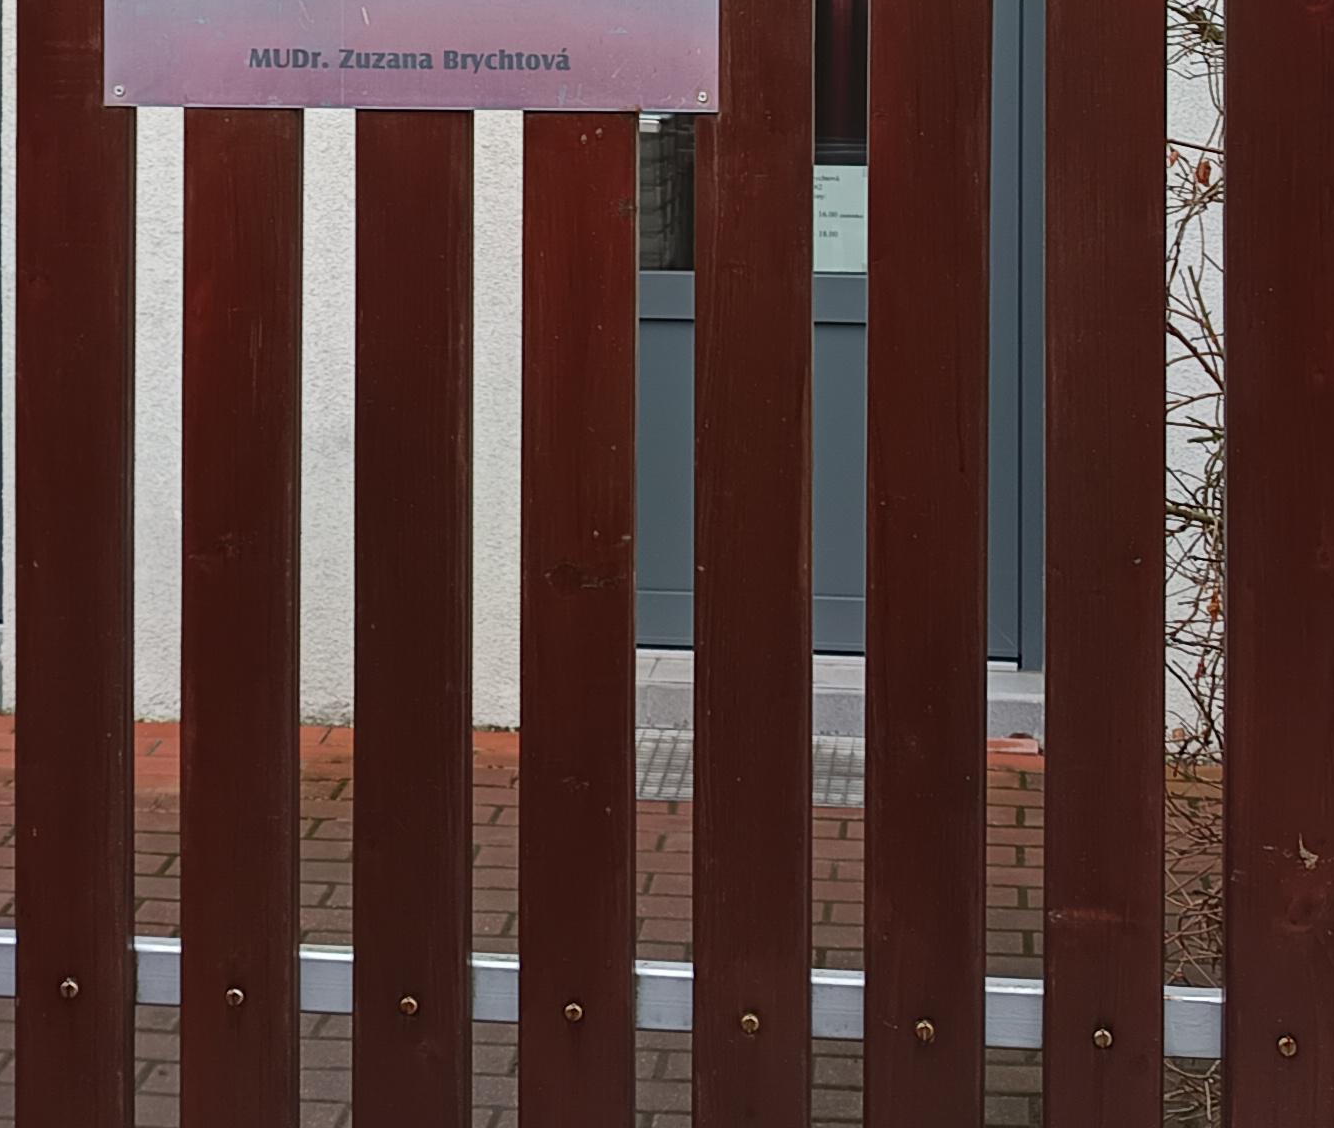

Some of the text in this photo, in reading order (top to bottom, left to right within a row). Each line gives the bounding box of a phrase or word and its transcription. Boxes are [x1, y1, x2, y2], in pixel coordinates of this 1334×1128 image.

[248, 48, 571, 75] MUDr. Zuzana Brychtová
